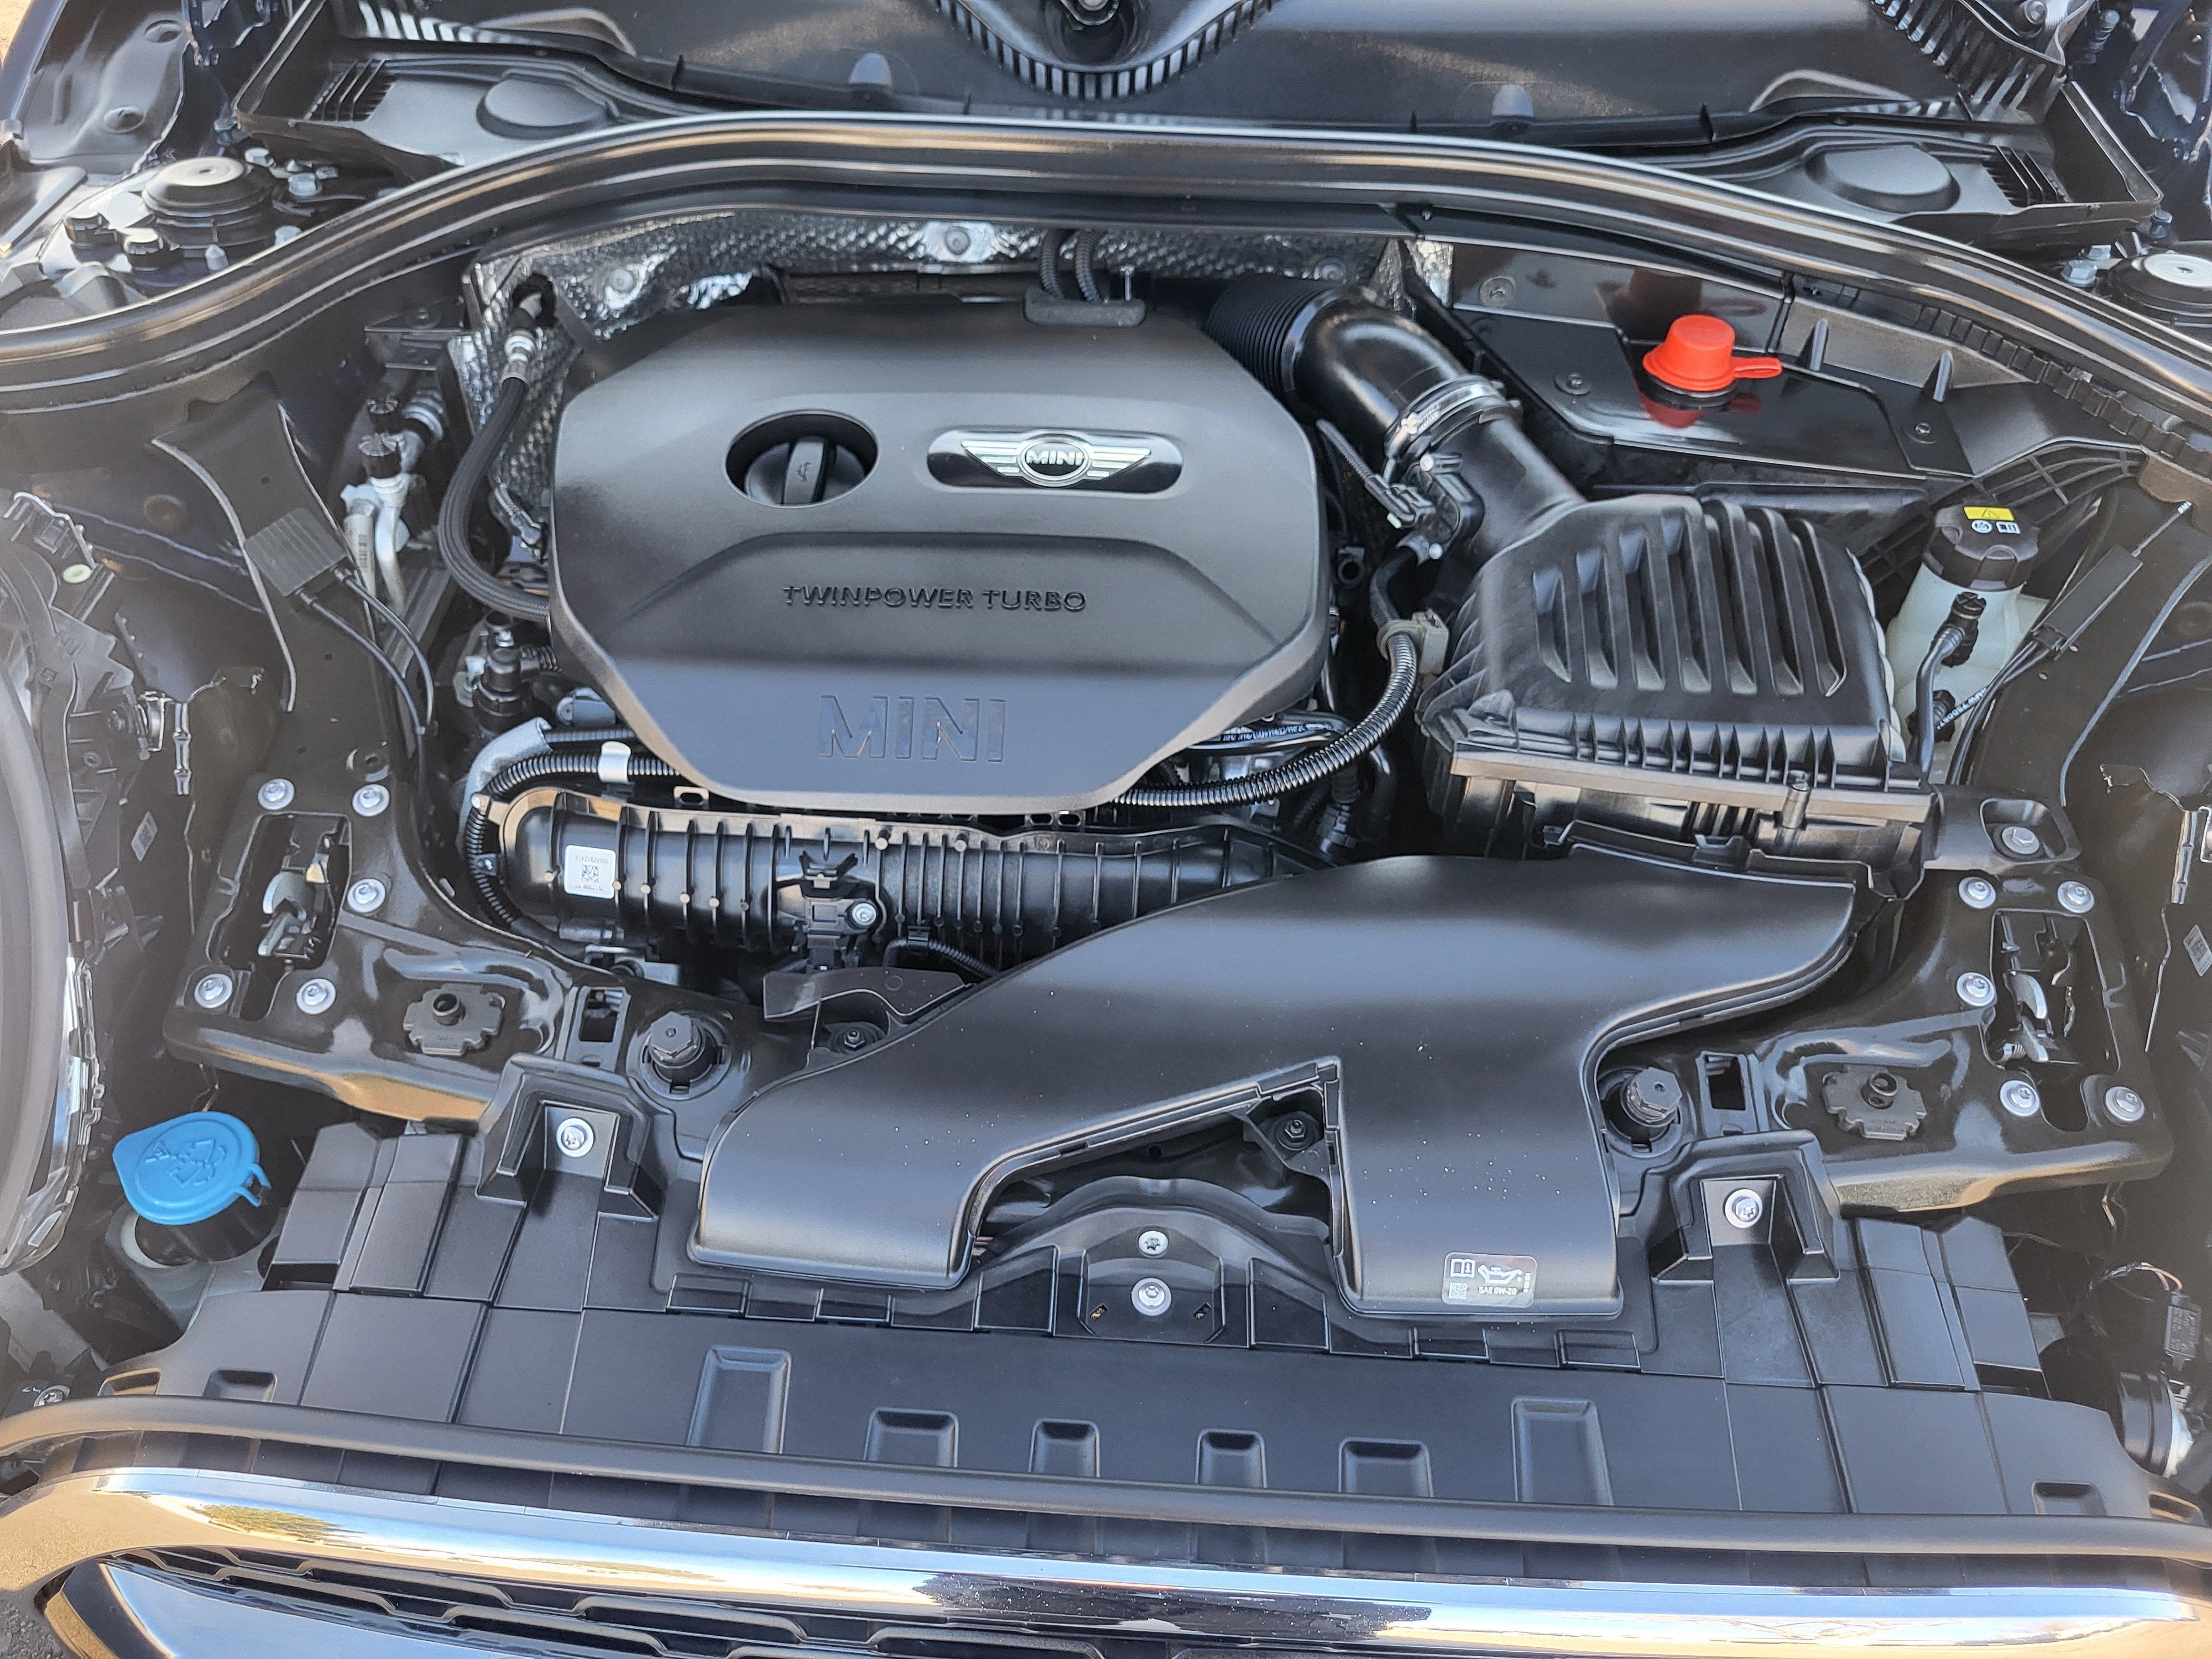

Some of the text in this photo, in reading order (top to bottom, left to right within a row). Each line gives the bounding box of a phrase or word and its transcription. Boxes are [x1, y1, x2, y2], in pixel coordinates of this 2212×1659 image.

[1026, 450, 1084, 466] MINI
[782, 585, 1086, 611] TWINPOWER TURBO
[817, 695, 1006, 762] MINI
[1478, 1286, 1517, 1296] SAE 0W-20
